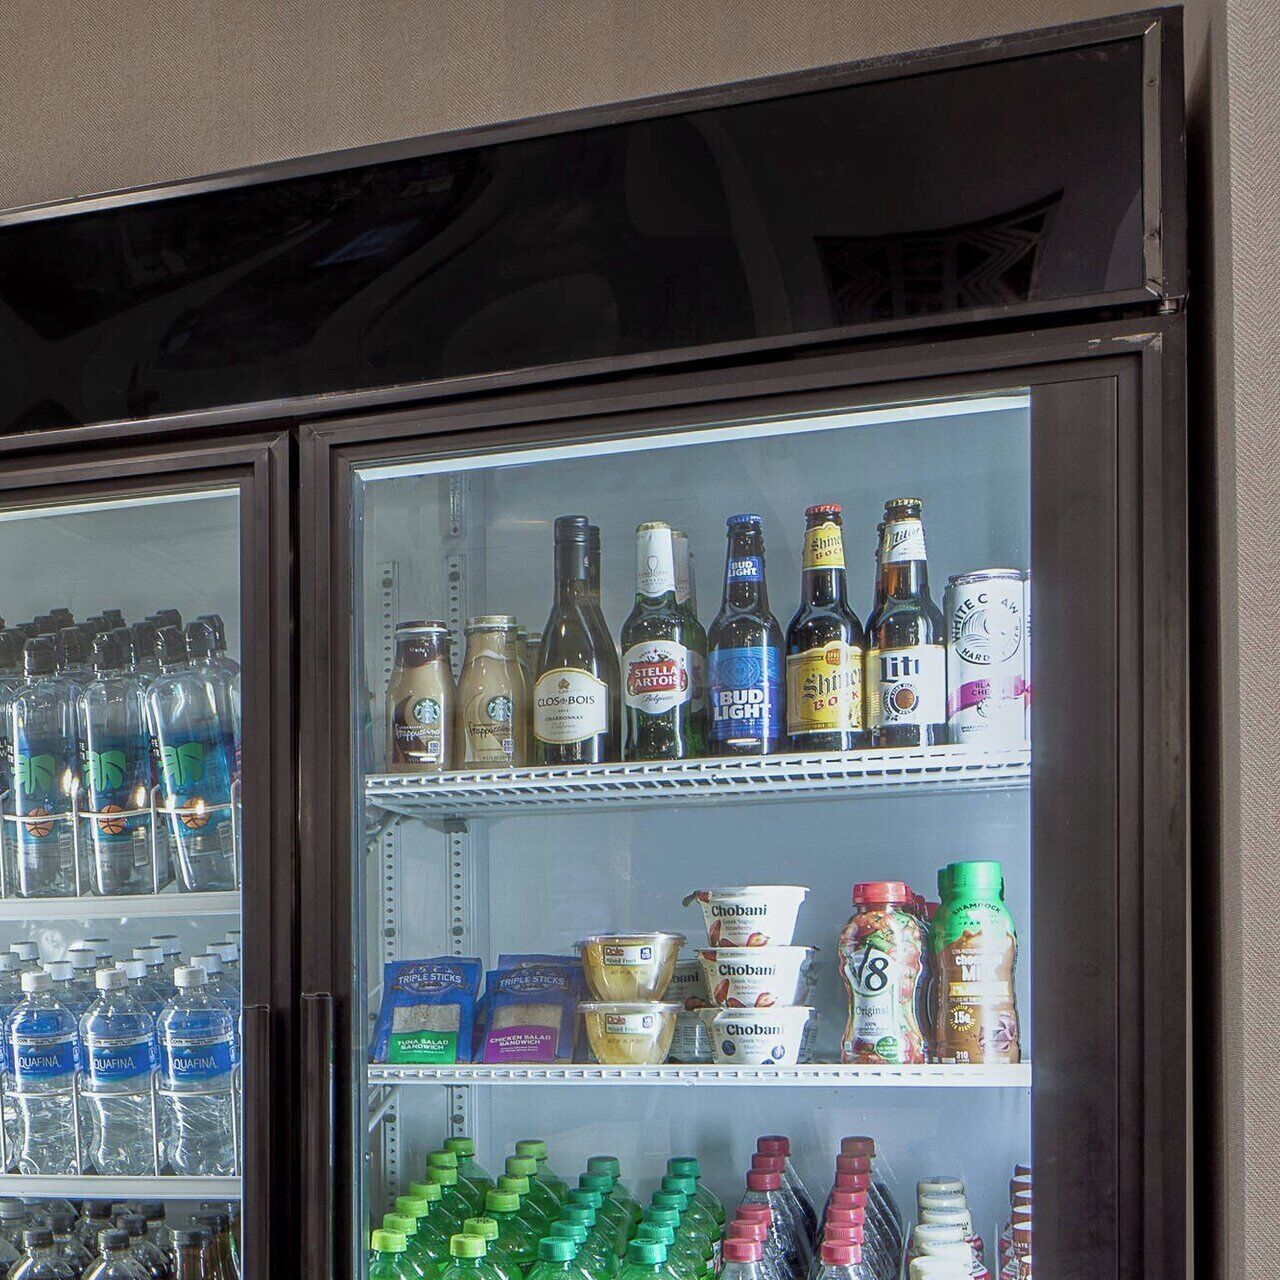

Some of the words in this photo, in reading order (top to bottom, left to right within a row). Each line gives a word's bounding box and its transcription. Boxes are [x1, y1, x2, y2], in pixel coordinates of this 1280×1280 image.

[731, 560, 754, 570] BUD
[728, 567, 757, 578] LIGHT
[952, 600, 976, 643] WHITE
[962, 648, 991, 665] HARD
[634, 666, 677, 679] STELLA
[635, 675, 680, 688] ARTOIS
[537, 696, 560, 708] CLOS
[568, 694, 595, 706] BOIS
[720, 690, 765, 704] BUD
[714, 705, 772, 721] LIGHT
[711, 903, 768, 918] Chobani
[718, 963, 777, 977] Chobani
[850, 942, 889, 992] V8
[398, 973, 429, 986] TRIPLE
[430, 972, 462, 984] STICKS
[500, 976, 530, 987] TRIPLE
[532, 974, 565, 986] STICKS
[397, 1038, 419, 1047] TUNA
[420, 1037, 449, 1045] SALAD
[490, 1034, 522, 1045] CHICKEN
[523, 1033, 552, 1041] SALAD
[408, 1043, 445, 1051] SANDWICH
